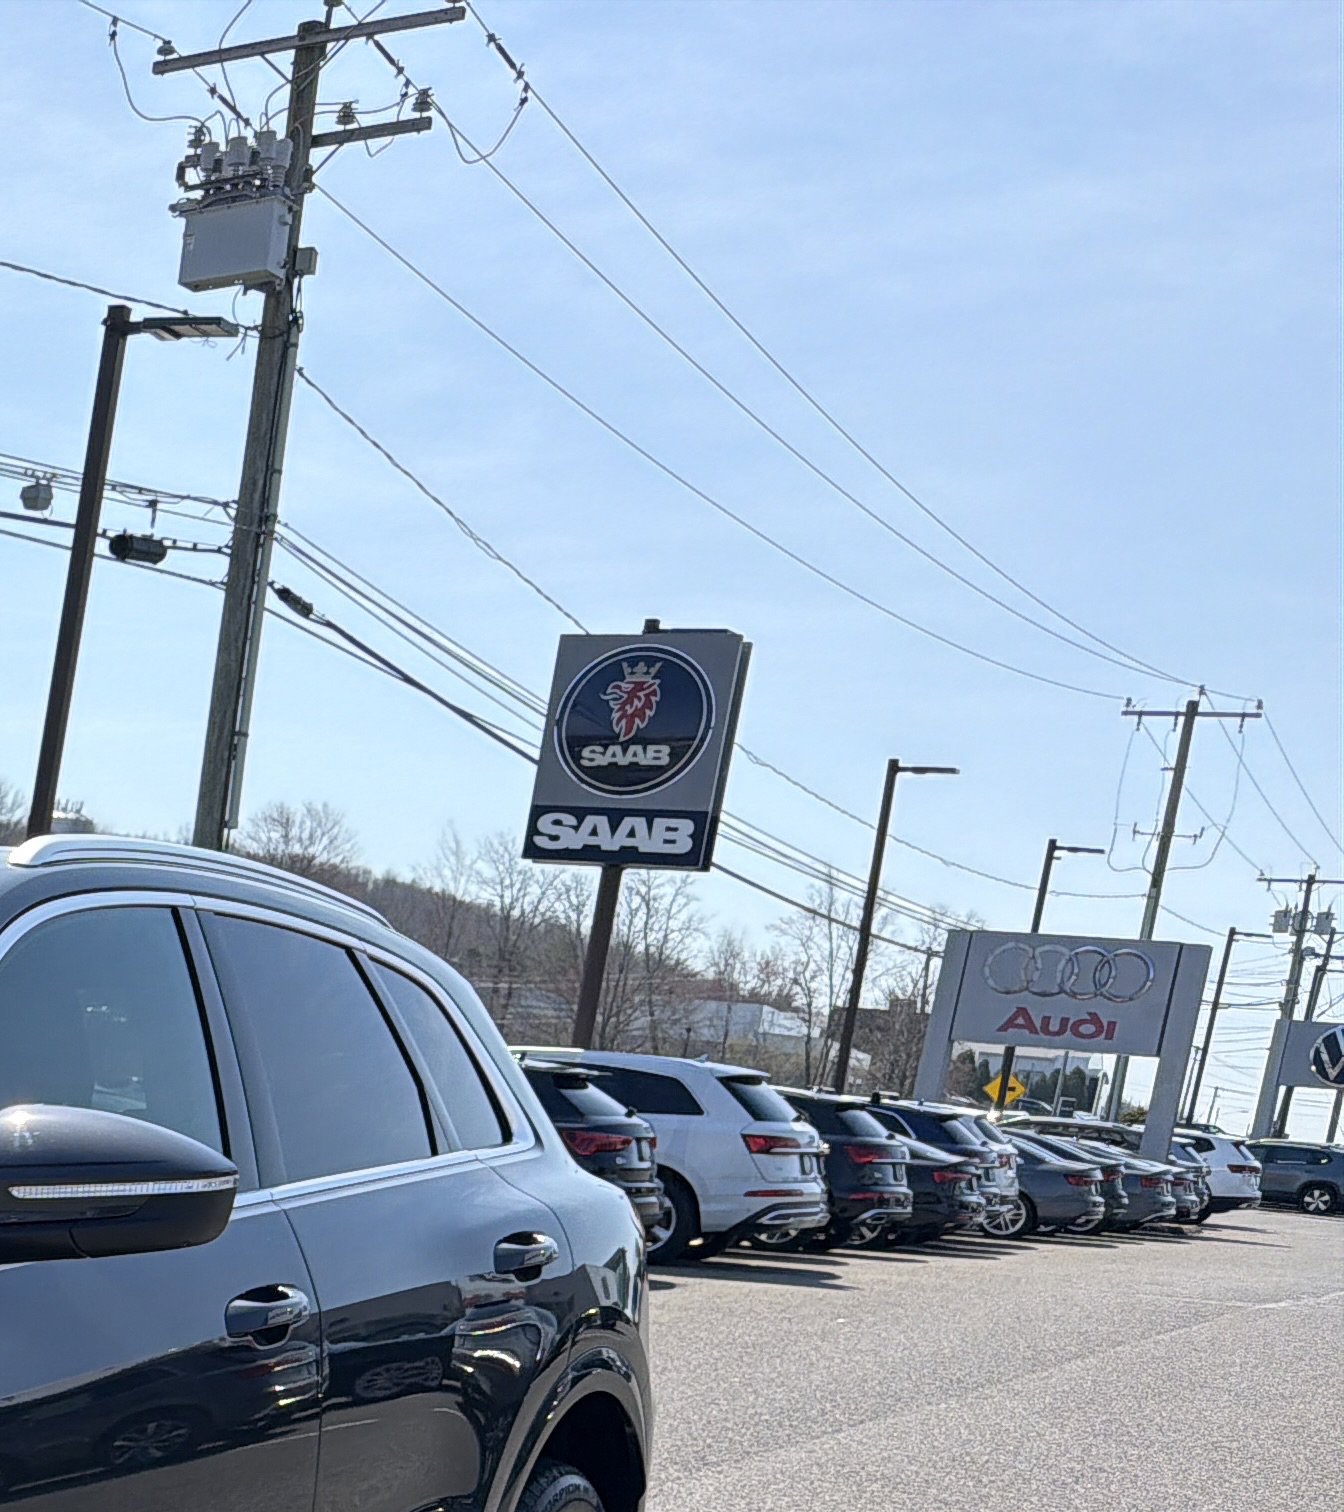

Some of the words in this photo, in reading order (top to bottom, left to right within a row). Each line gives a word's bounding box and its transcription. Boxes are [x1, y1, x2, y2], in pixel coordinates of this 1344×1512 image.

[580, 744, 671, 767] SAAB
[532, 812, 695, 855] SAAB
[996, 1007, 1117, 1041] Audi
